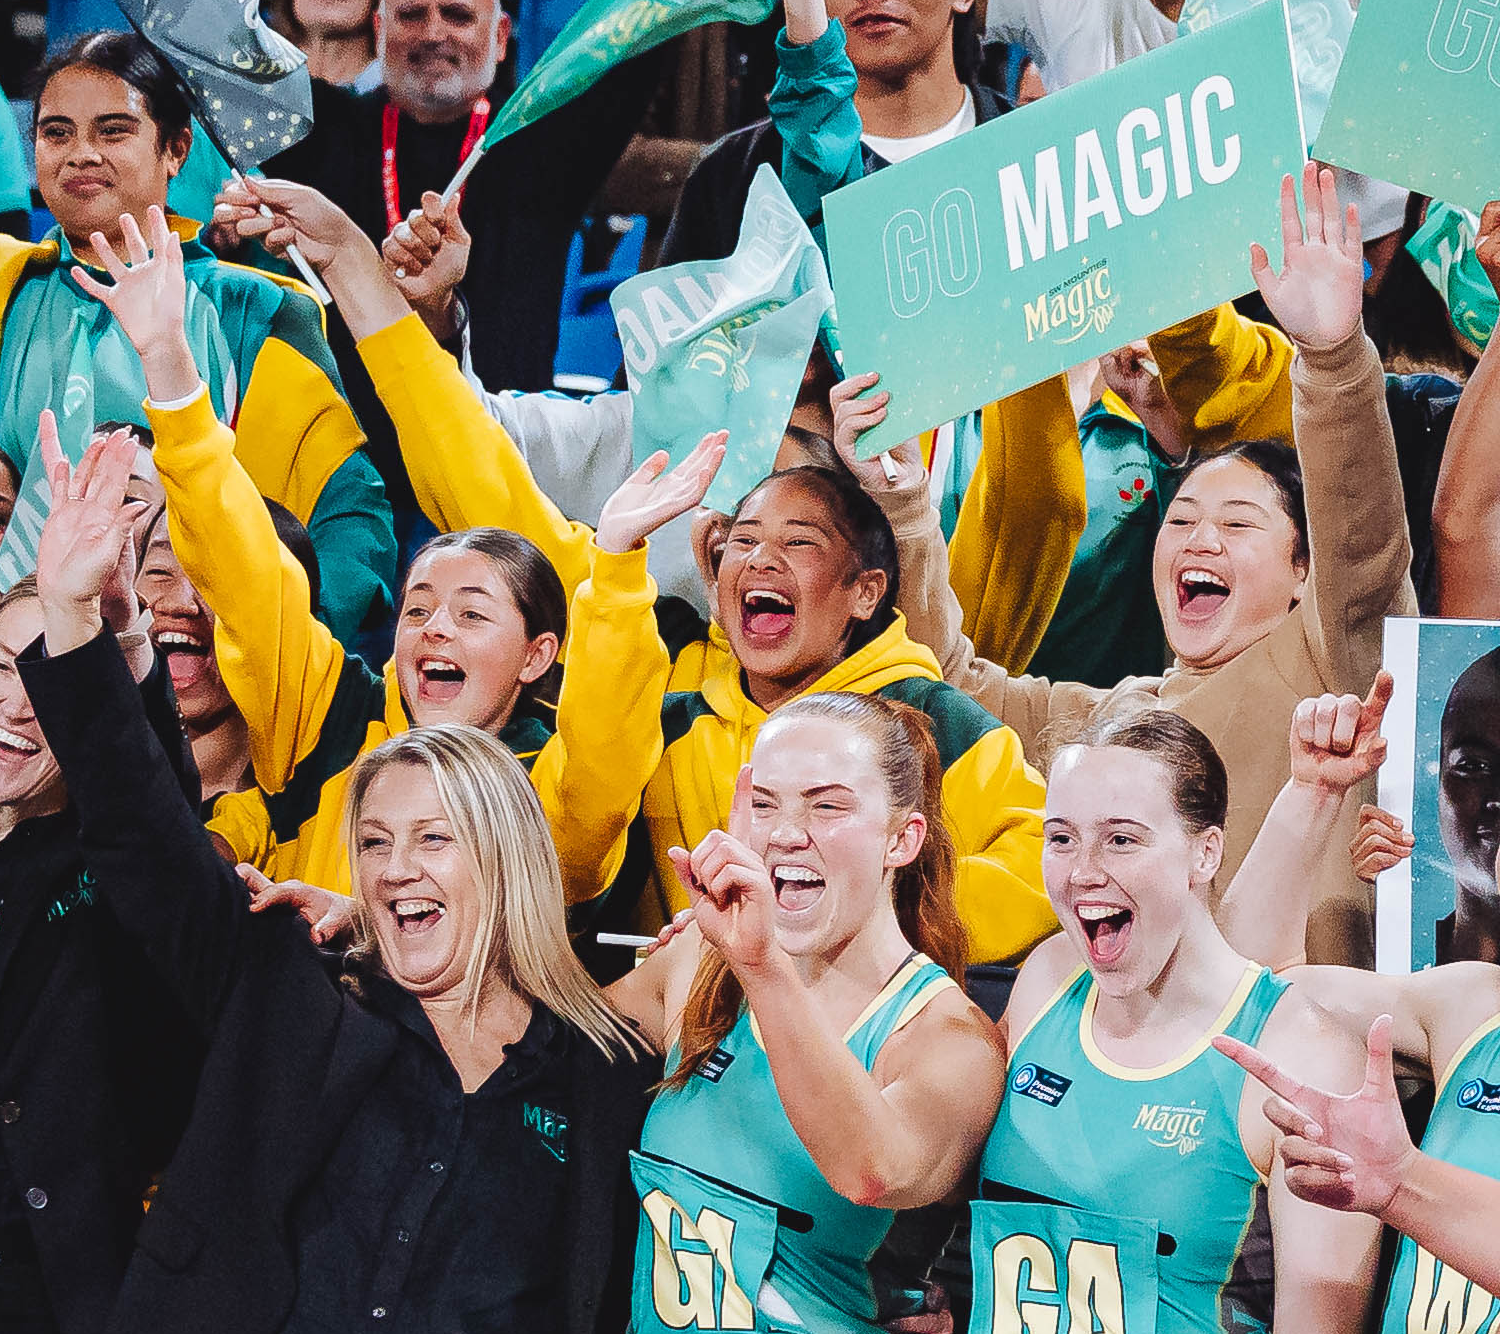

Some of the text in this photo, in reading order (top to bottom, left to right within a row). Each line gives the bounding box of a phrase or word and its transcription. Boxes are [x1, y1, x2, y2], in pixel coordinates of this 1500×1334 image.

[883, 75, 1242, 319] GO MAGIC
[1063, 258, 1108, 290] MOUNTIES
[1024, 269, 1112, 343] Magic
[1027, 1087, 1055, 1103] League
[1031, 1080, 1063, 1097] Premier
[1132, 1105, 1204, 1142] Magic
